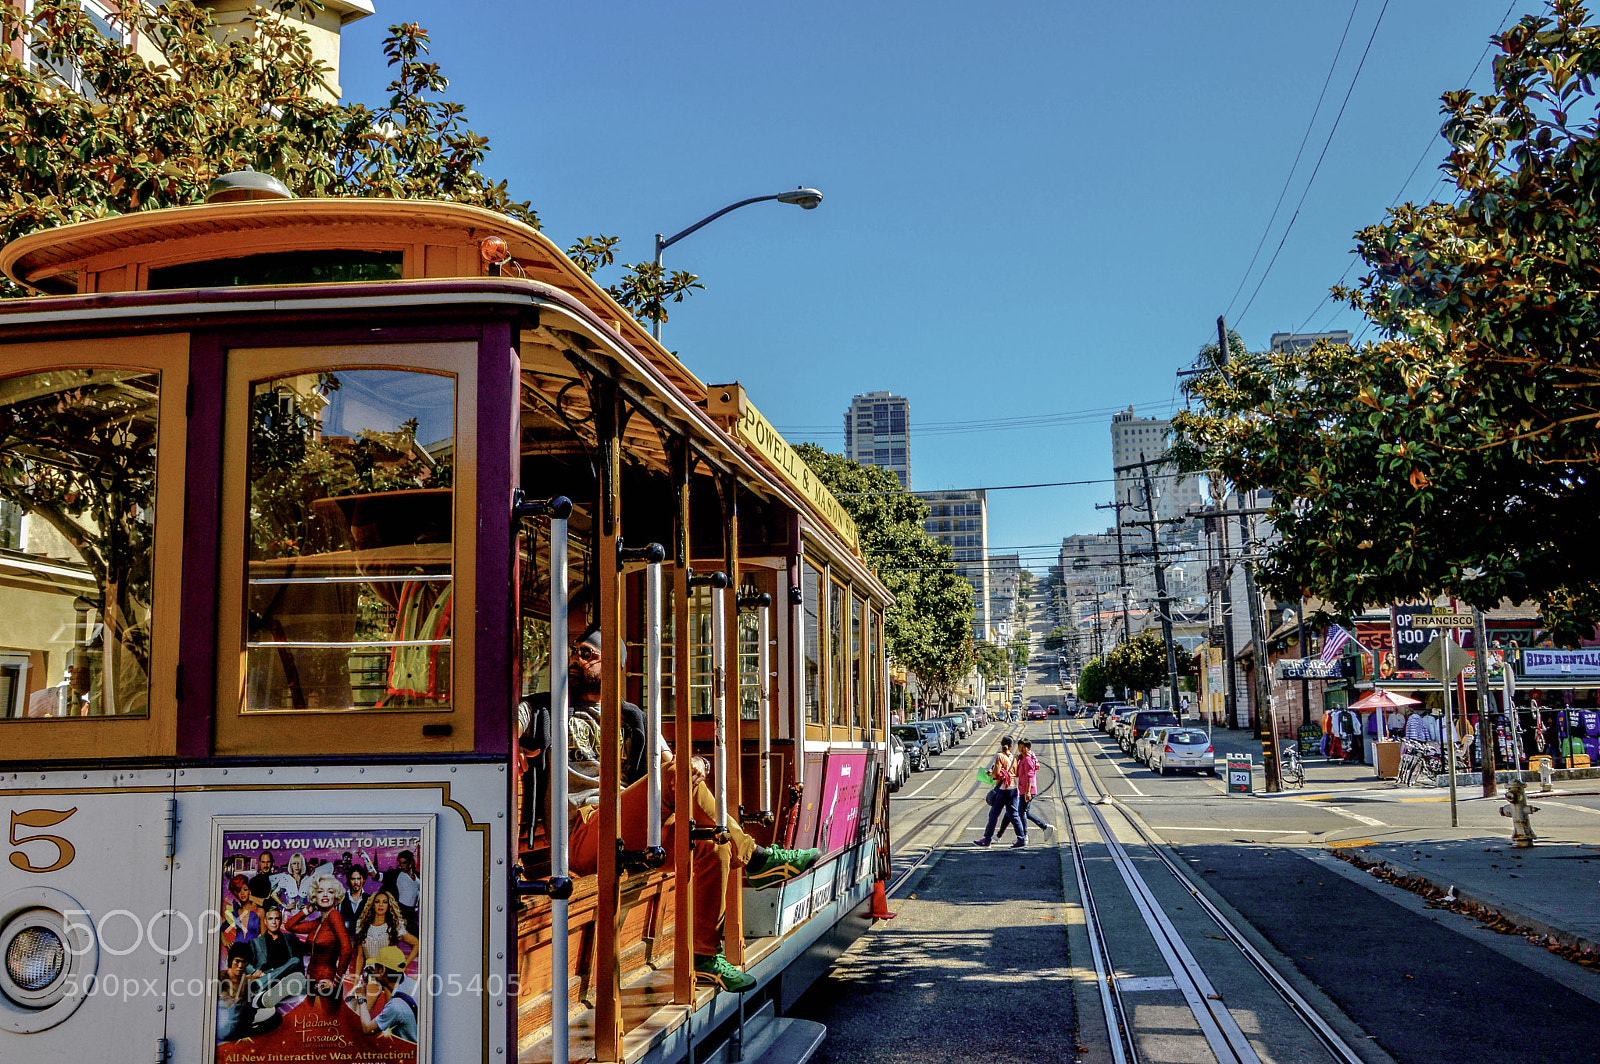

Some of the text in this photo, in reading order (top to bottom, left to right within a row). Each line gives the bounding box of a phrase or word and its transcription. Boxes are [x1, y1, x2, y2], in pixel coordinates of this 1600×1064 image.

[744, 406, 798, 480] POWELL
[814, 482, 843, 529] MASON
[1415, 616, 1473, 625] FRANCISCO
[1396, 629, 1424, 644] 1:00
[1526, 652, 1553, 667] BIKE
[9, 806, 78, 873] 5
[227, 836, 420, 850] WHO DO YOU WANT TO MEET?
[294, 1013, 341, 1028] Madame
[295, 1028, 346, 1048] Tussauds
[225, 1050, 414, 1062] All New Interactive Wax Attraction!
